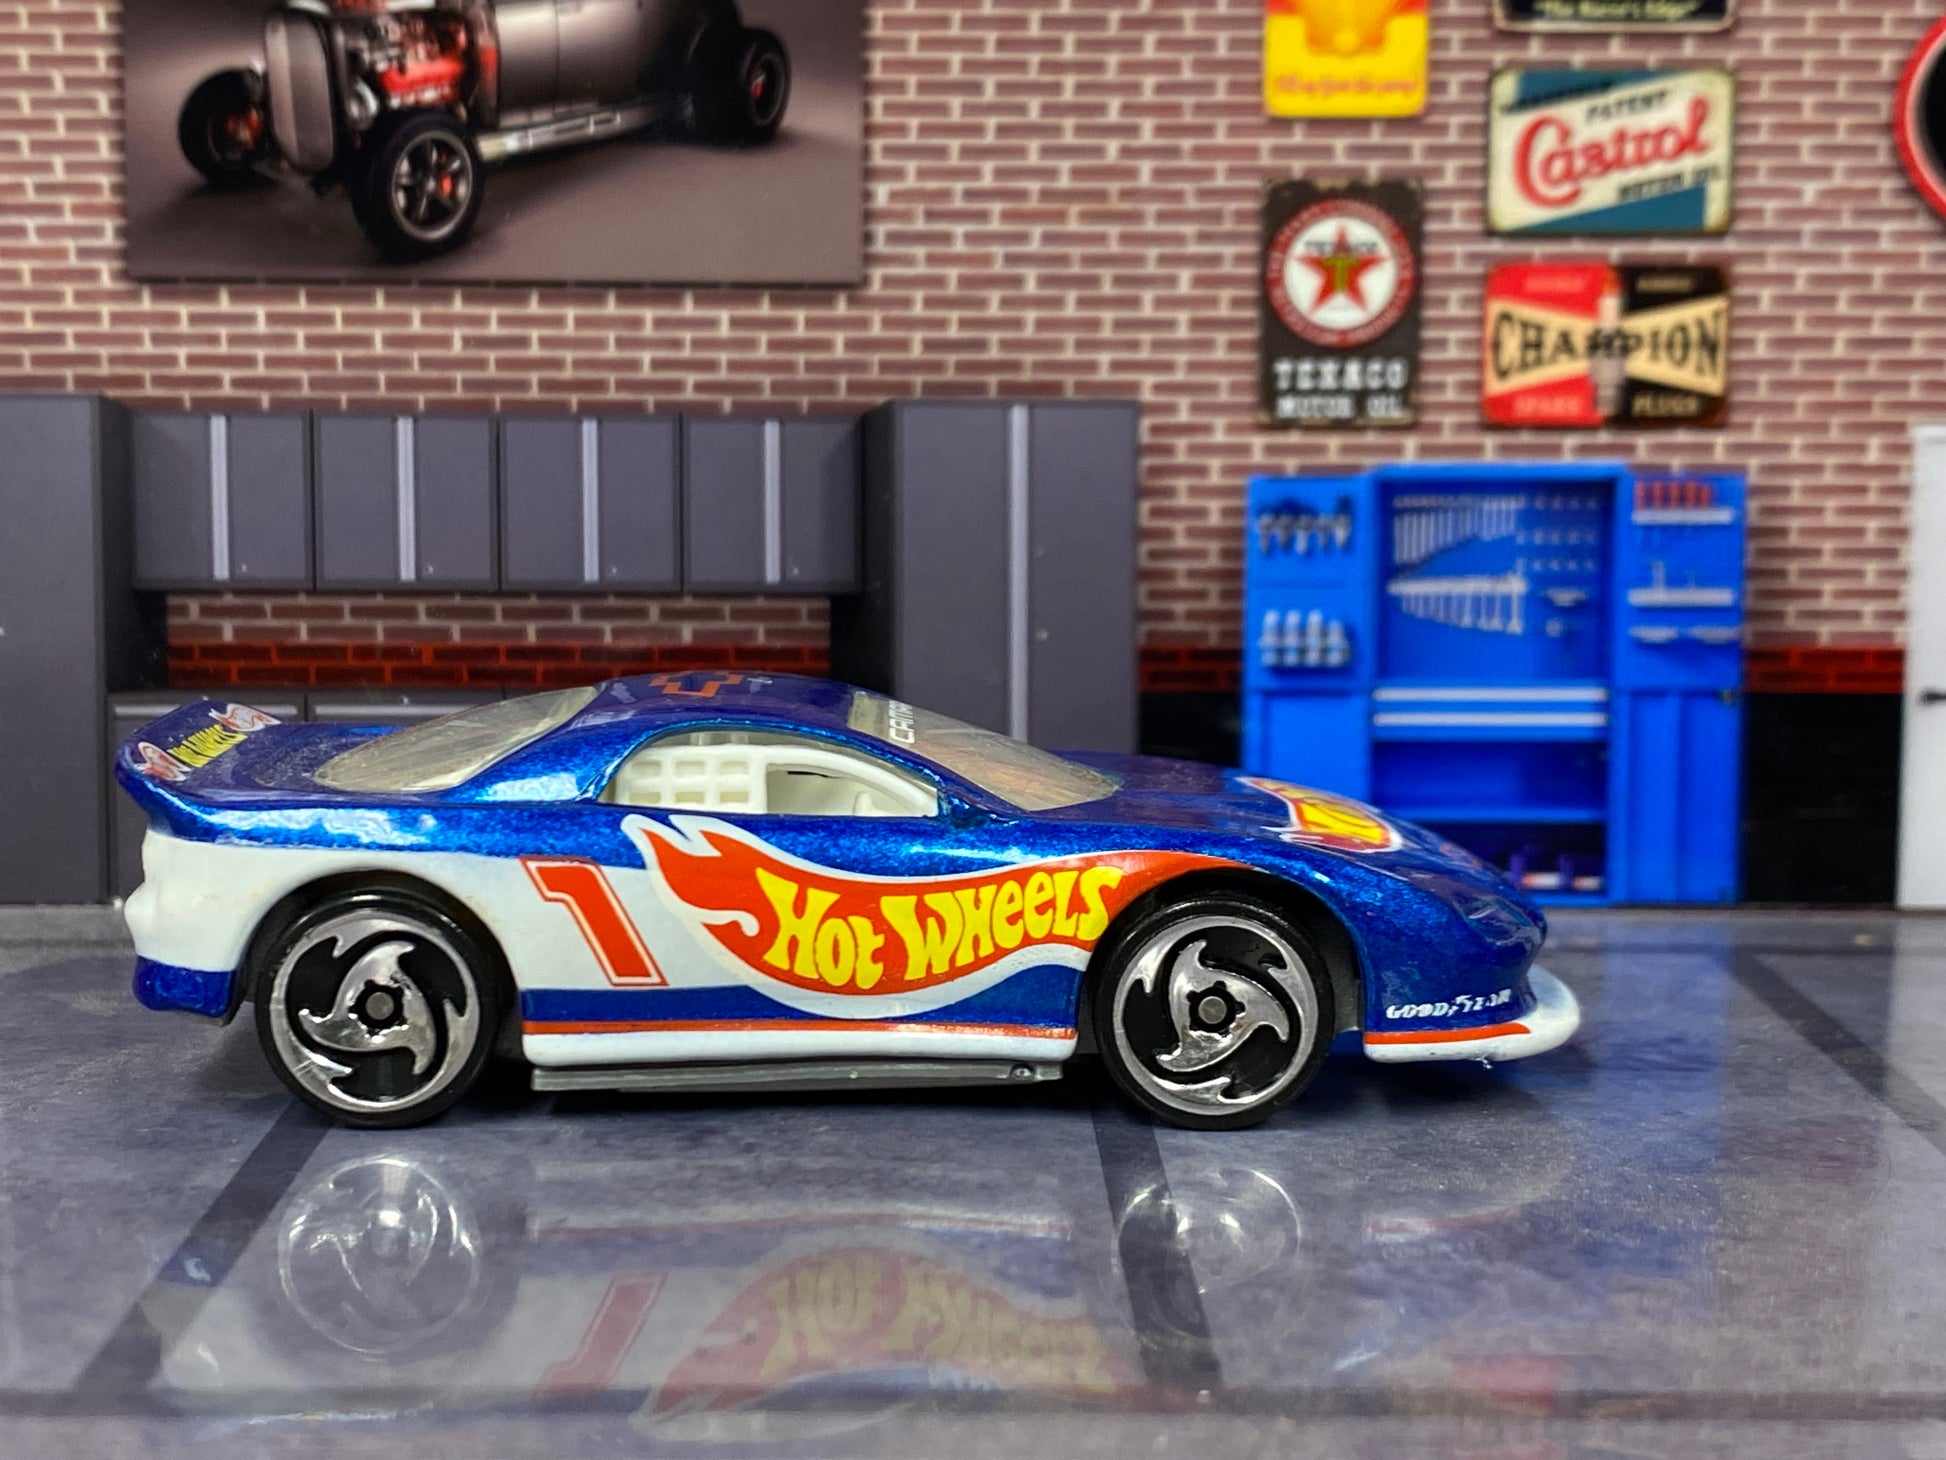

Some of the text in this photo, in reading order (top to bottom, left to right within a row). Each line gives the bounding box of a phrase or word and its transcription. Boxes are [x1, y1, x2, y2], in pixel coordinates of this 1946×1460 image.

[1513, 96, 1708, 208] Castrol
[1273, 356, 1409, 390] TEXACO
[519, 856, 669, 987] 1
